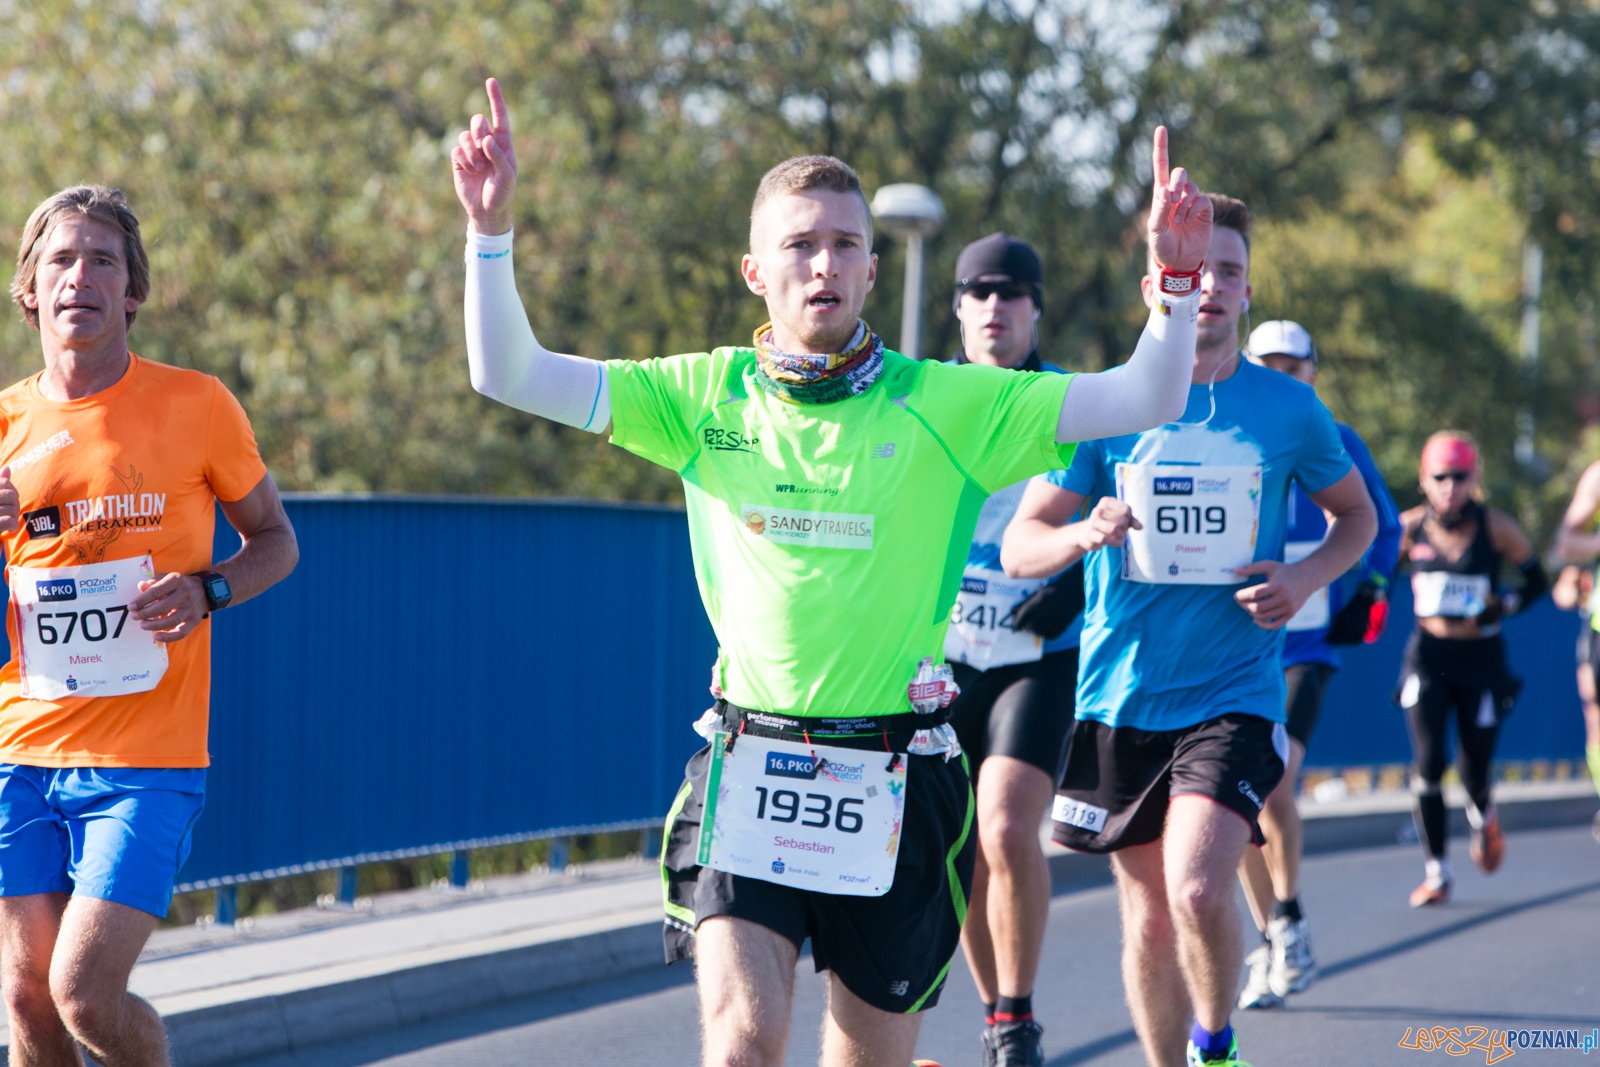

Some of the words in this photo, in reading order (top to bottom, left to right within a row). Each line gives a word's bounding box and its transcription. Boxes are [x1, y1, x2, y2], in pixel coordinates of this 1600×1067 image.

[9, 430, 71, 473] FINISHER
[65, 493, 166, 525] TRIATHLON
[31, 515, 55, 533] JBL
[1156, 506, 1227, 534] 6119
[80, 584, 117, 595] maraton
[37, 604, 129, 645] 6707
[69, 654, 103, 665] Marek
[747, 713, 799, 727] performance
[754, 720, 784, 730] recovery
[755, 786, 864, 834] 1936
[1062, 804, 1096, 825] 6119
[774, 835, 835, 855] Sebastian
